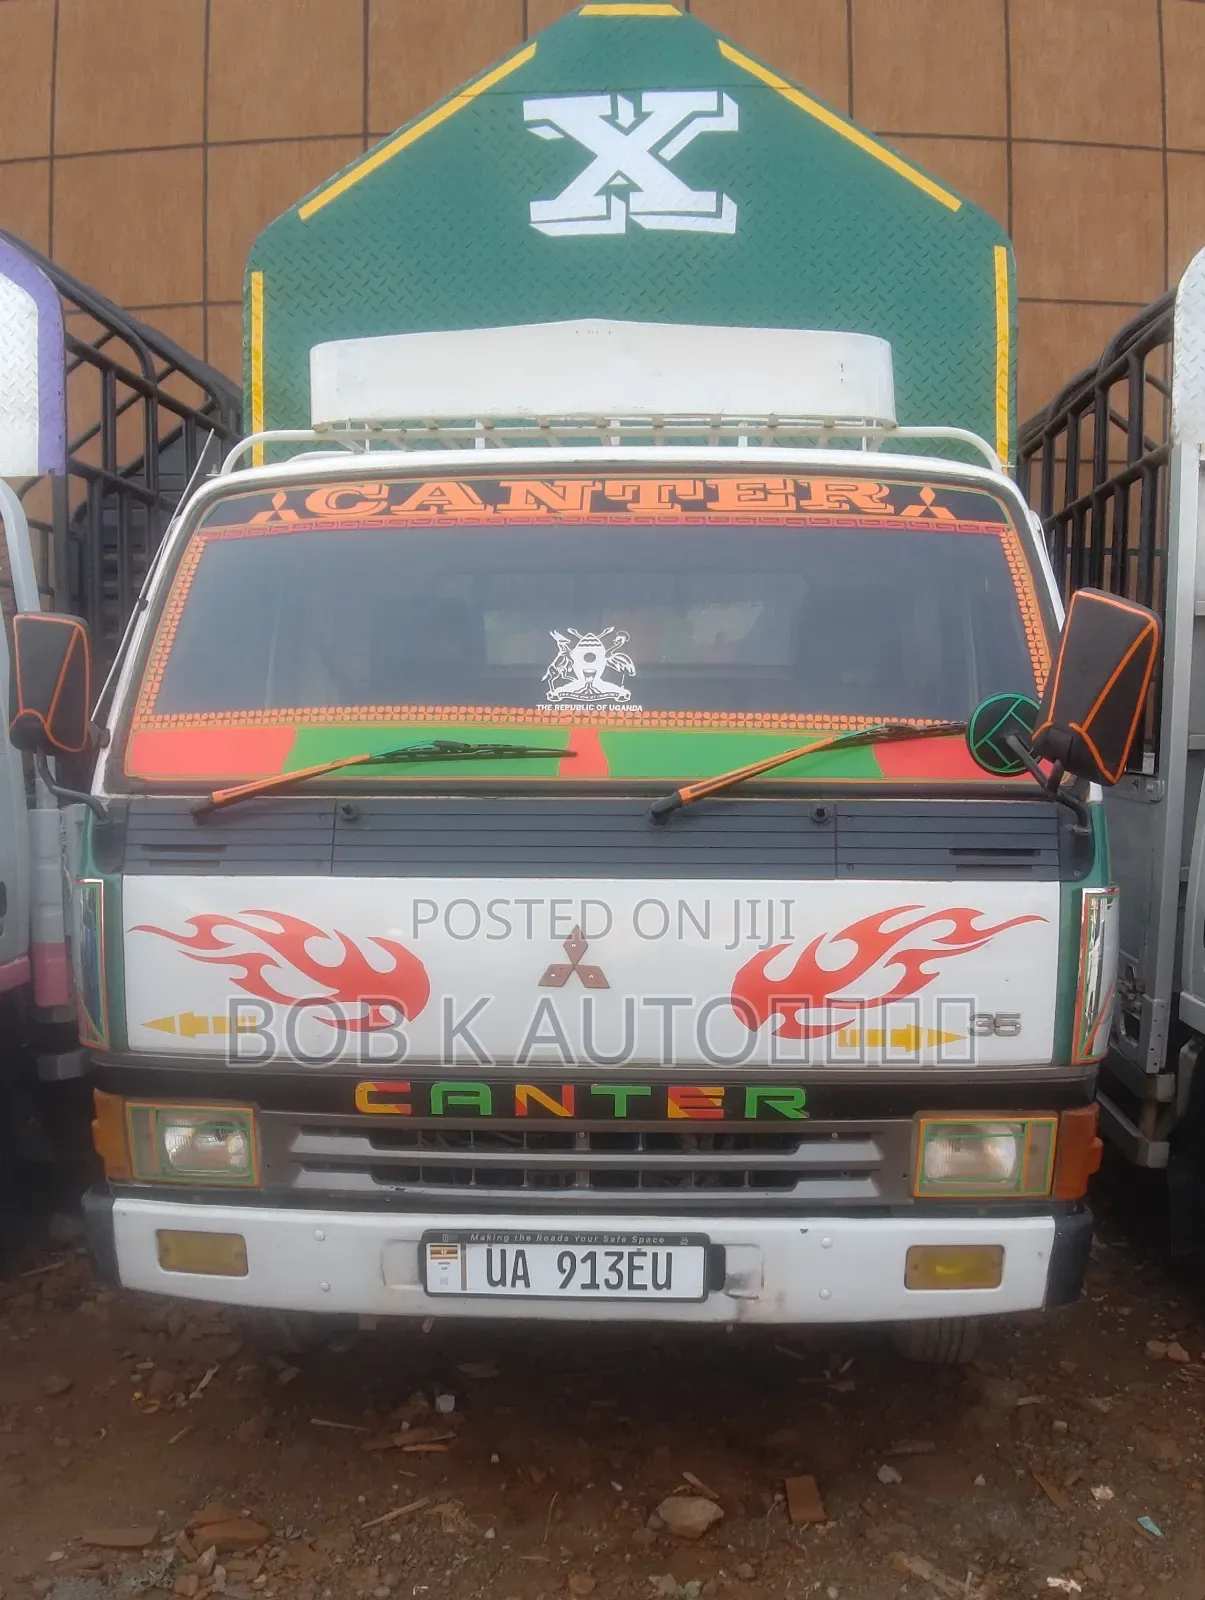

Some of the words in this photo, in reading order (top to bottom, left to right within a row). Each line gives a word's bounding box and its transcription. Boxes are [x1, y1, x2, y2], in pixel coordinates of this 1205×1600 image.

[522, 91, 739, 237] X
[305, 478, 895, 518] CANTER
[609, 704, 643, 712] UGANDA
[967, 1011, 1022, 1037] 35
[354, 1081, 810, 1119] CANTER
[470, 1233, 510, 1243] Making
[514, 1233, 532, 1242] the
[536, 1233, 569, 1242] Roads
[574, 1234, 599, 1243] Your
[603, 1235, 627, 1243] Safe
[631, 1235, 665, 1245] Space
[486, 1248, 531, 1288] UA
[557, 1249, 673, 1291] 913EU
